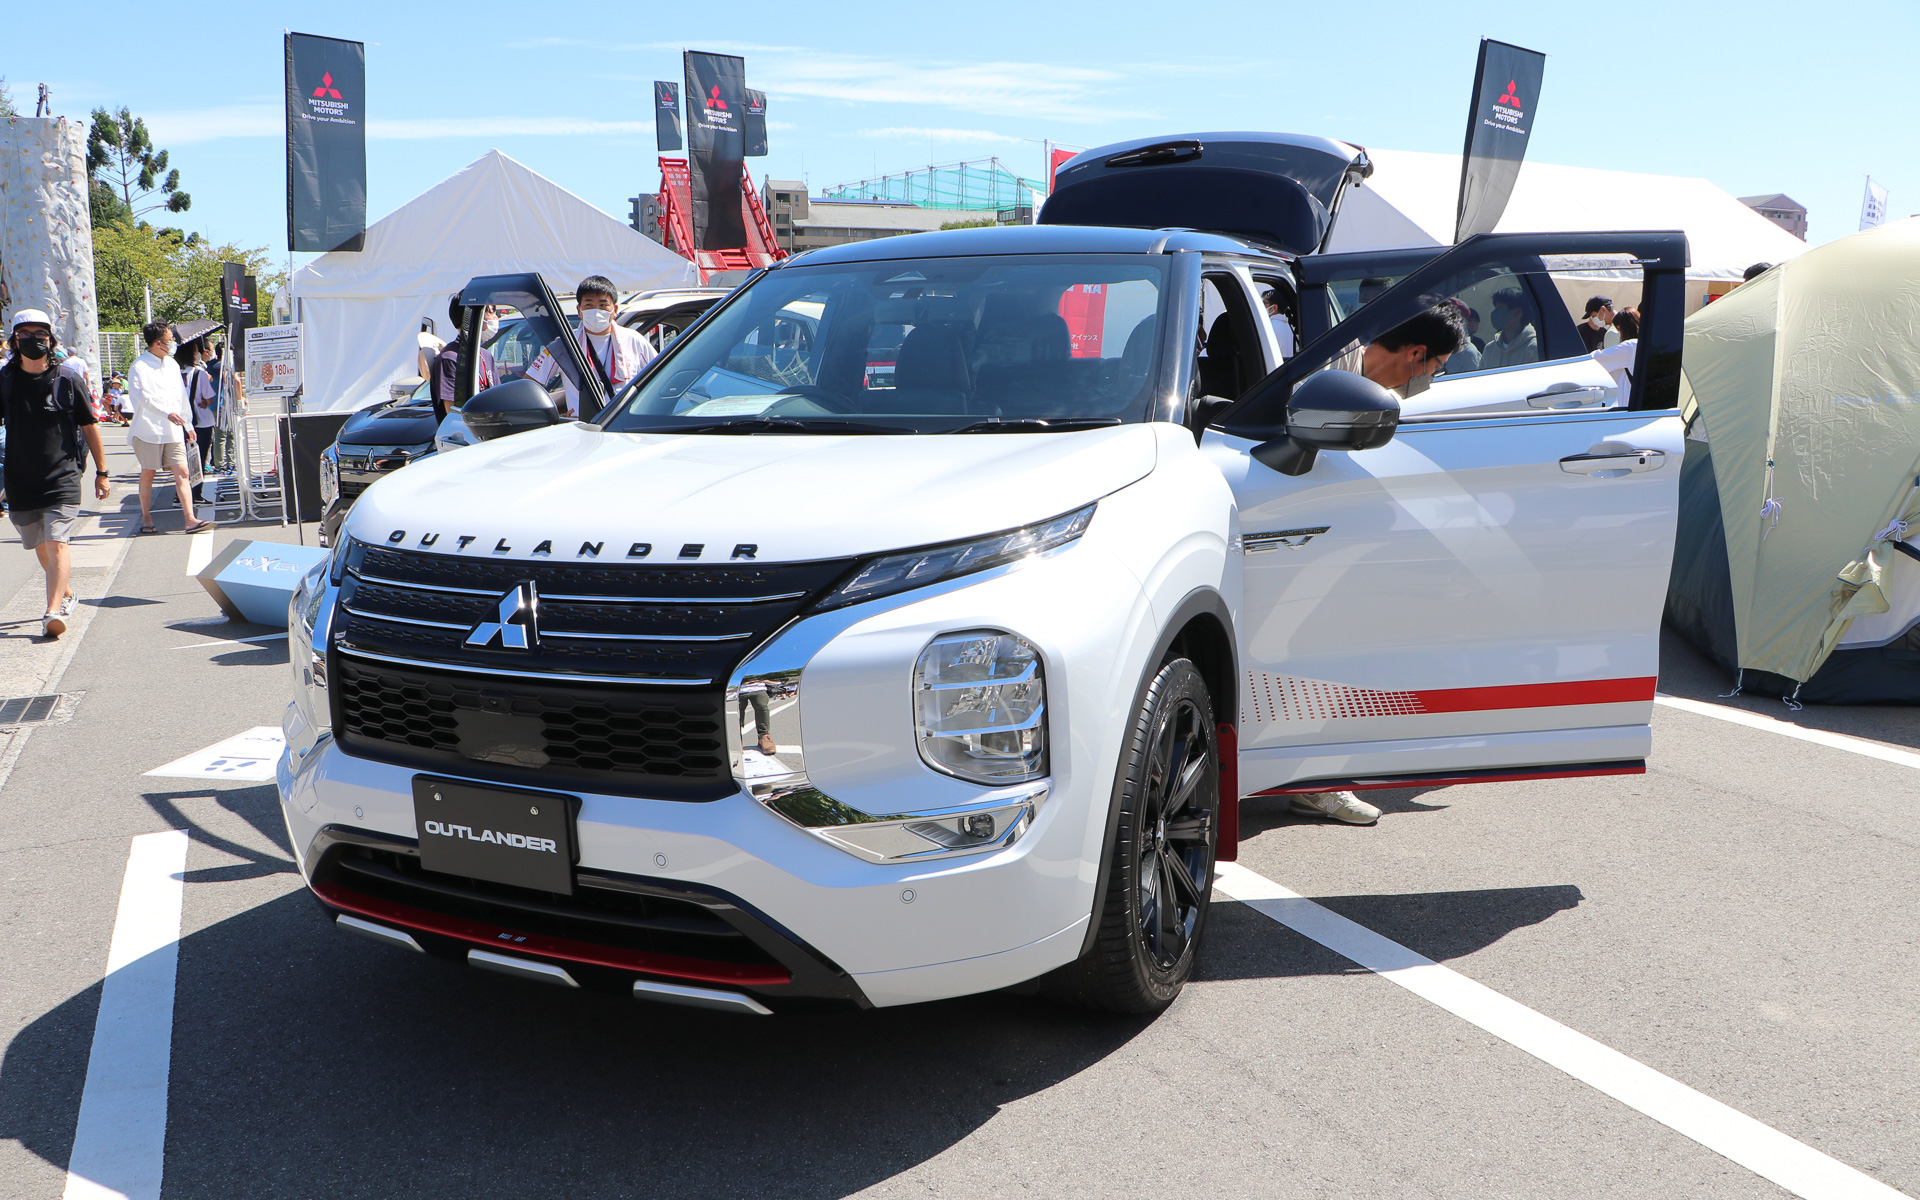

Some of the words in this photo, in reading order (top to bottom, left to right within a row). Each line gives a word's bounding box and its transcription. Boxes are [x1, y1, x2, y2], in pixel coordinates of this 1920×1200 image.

[308, 98, 349, 110] MITSUBISHI
[313, 106, 344, 116] MOTORS
[1492, 104, 1524, 119] MITSUBISHI
[301, 112, 317, 121] Drive
[329, 117, 356, 125] Ambition
[1495, 112, 1519, 125] MOTORS
[387, 530, 758, 560] OUTLANDER
[424, 820, 558, 854] OUTLANDER
